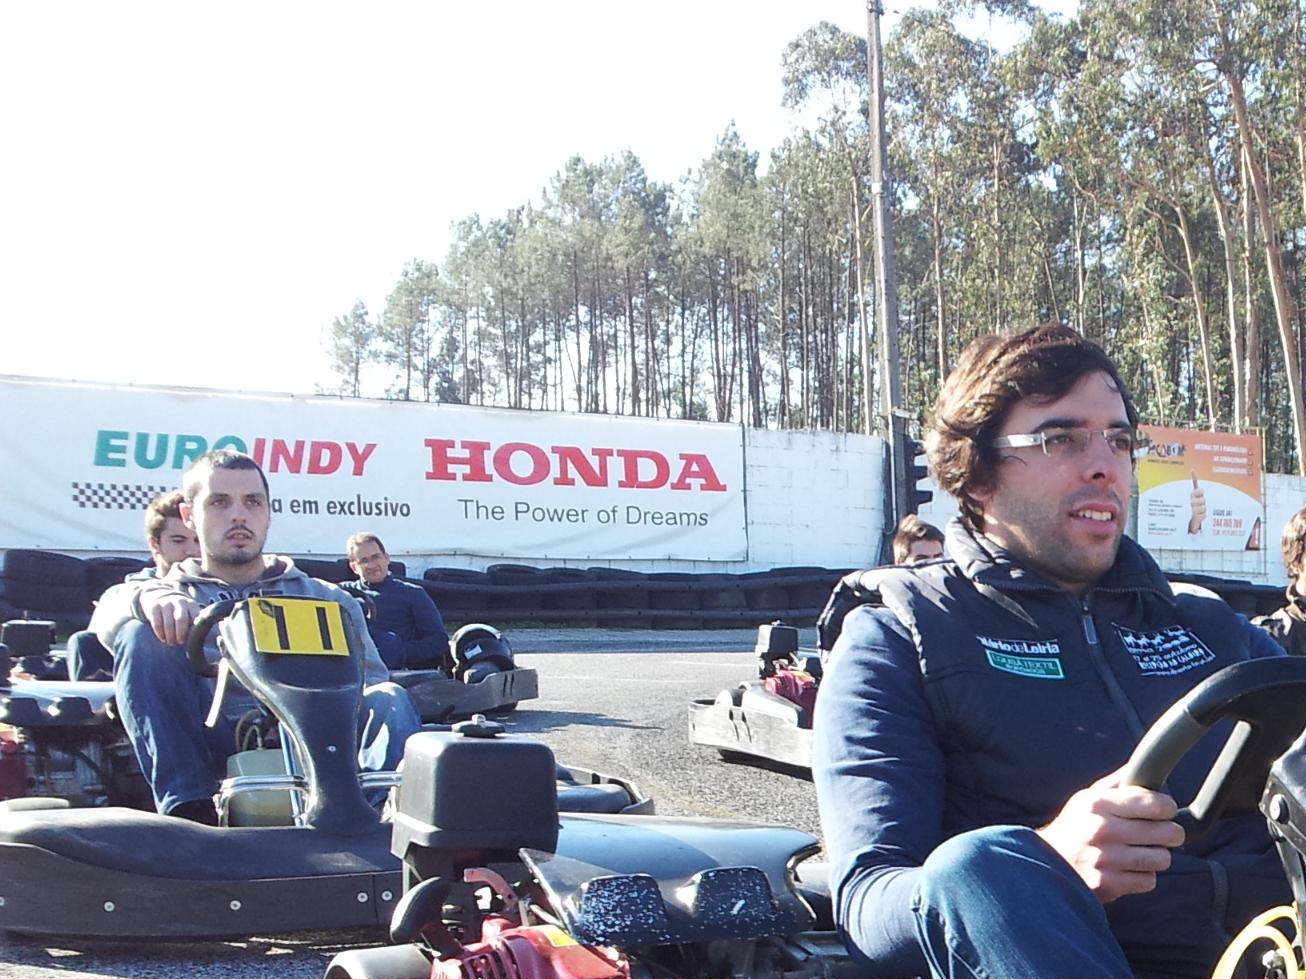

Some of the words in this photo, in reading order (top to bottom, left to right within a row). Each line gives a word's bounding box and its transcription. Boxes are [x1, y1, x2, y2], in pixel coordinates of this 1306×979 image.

[424, 438, 727, 492] HONDA
[291, 500, 319, 515] em
[327, 494, 411, 518] exclusivo
[457, 499, 505, 520] The
[515, 502, 588, 525] Power
[597, 505, 618, 524] of
[626, 506, 709, 527] Dreams
[274, 605, 333, 650] 11
